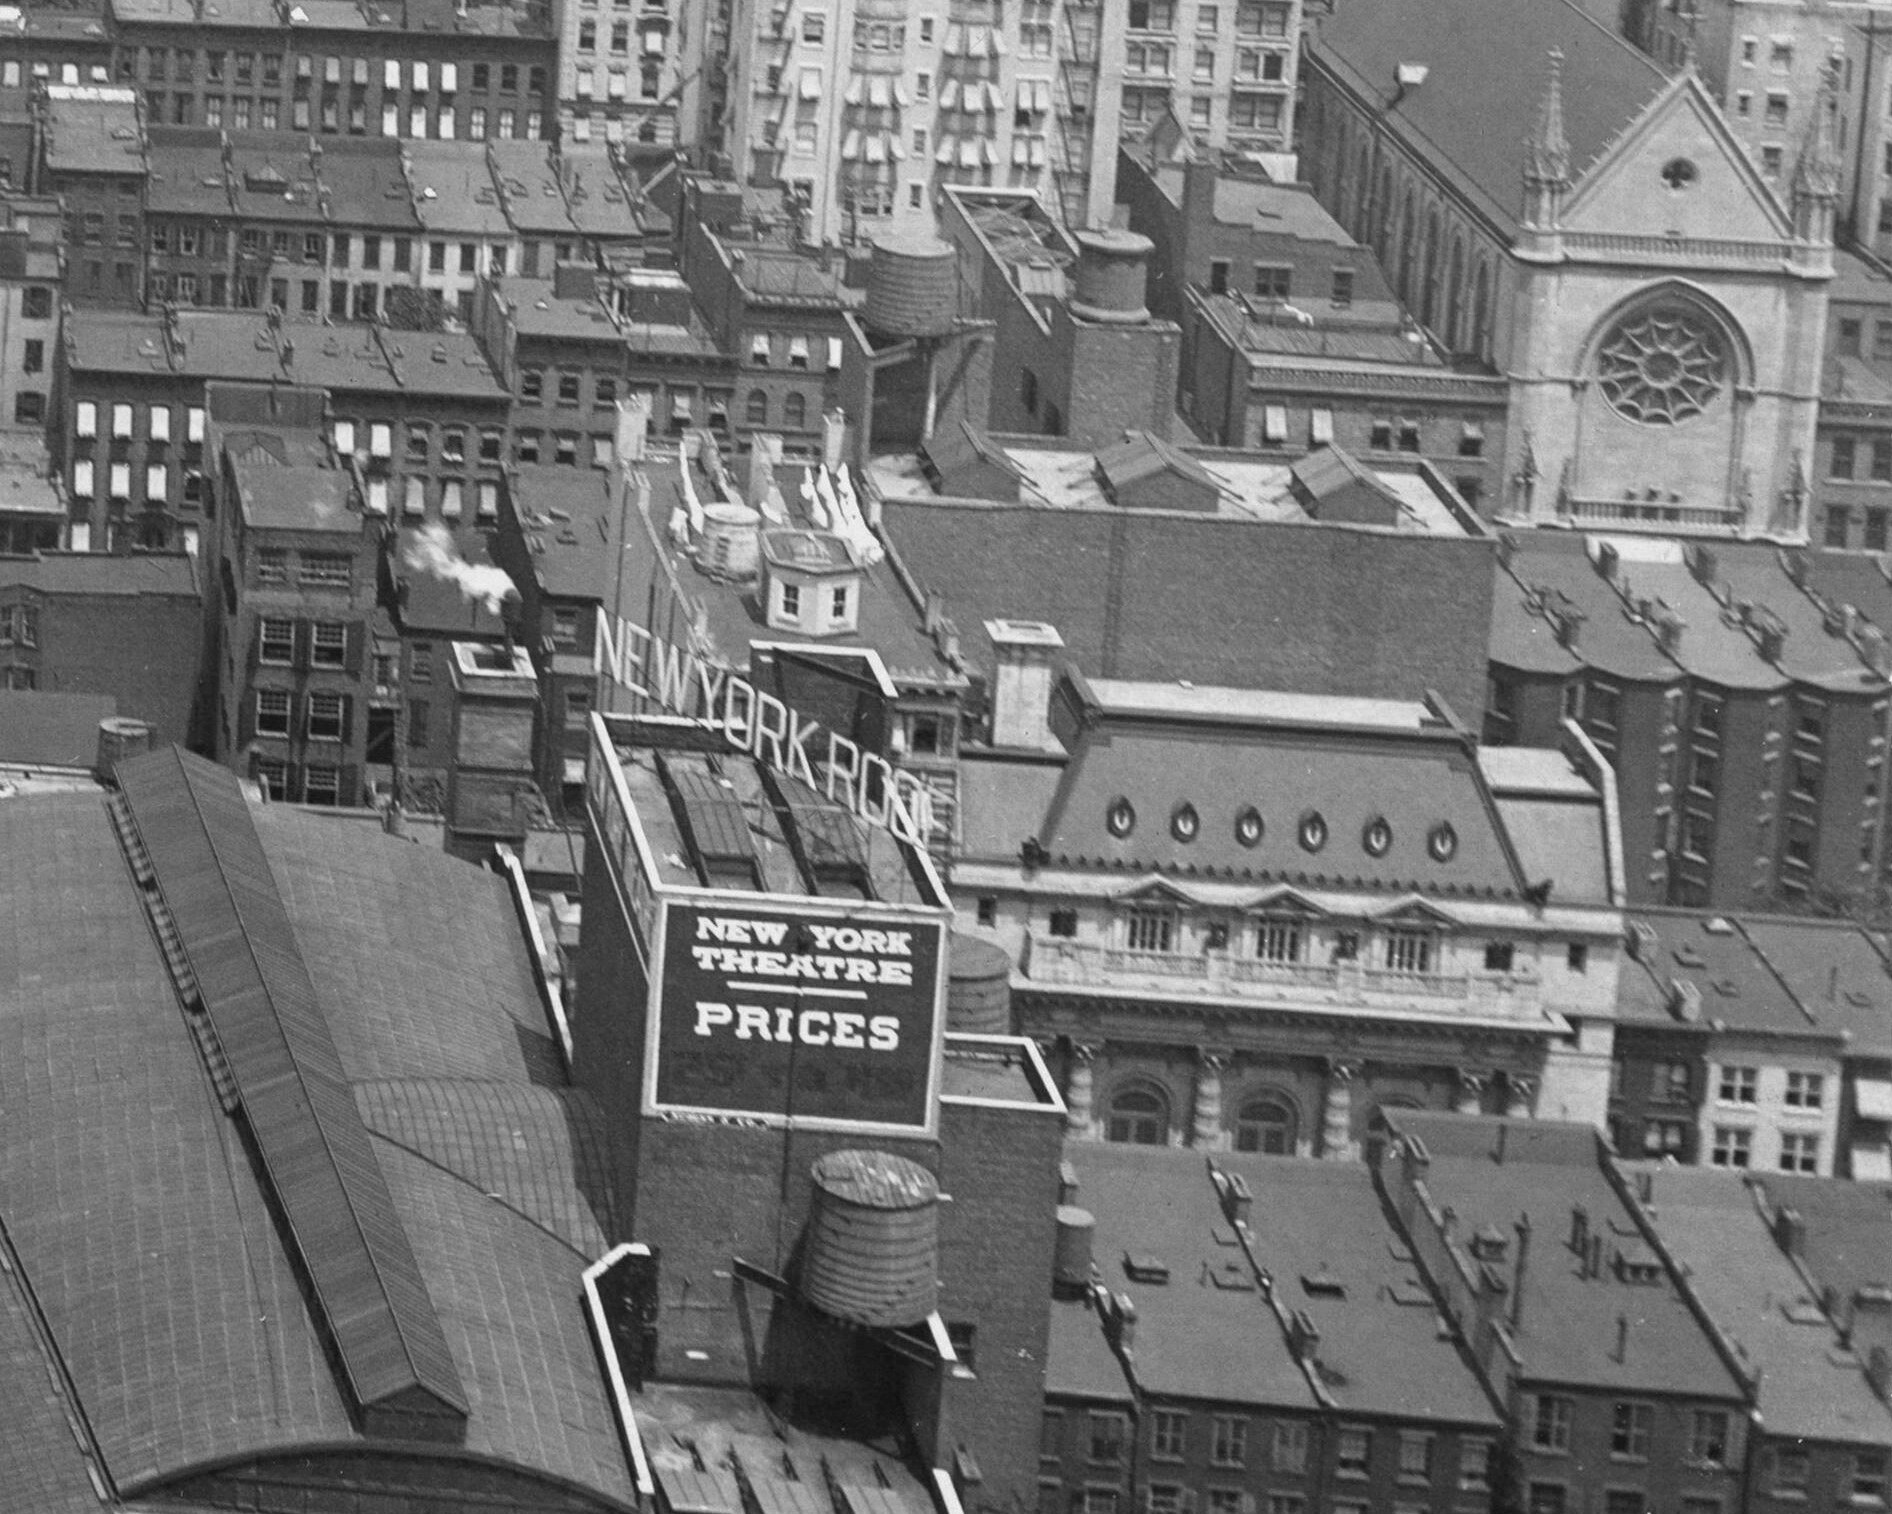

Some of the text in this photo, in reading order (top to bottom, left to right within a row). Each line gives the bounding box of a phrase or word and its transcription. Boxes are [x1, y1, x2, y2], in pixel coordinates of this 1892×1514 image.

[595, 605, 693, 714] NEW
[695, 659, 819, 792] YORK
[695, 916, 913, 956] NEW YORK
[691, 945, 914, 986] THEATRE
[693, 1001, 901, 1052] PRICES
